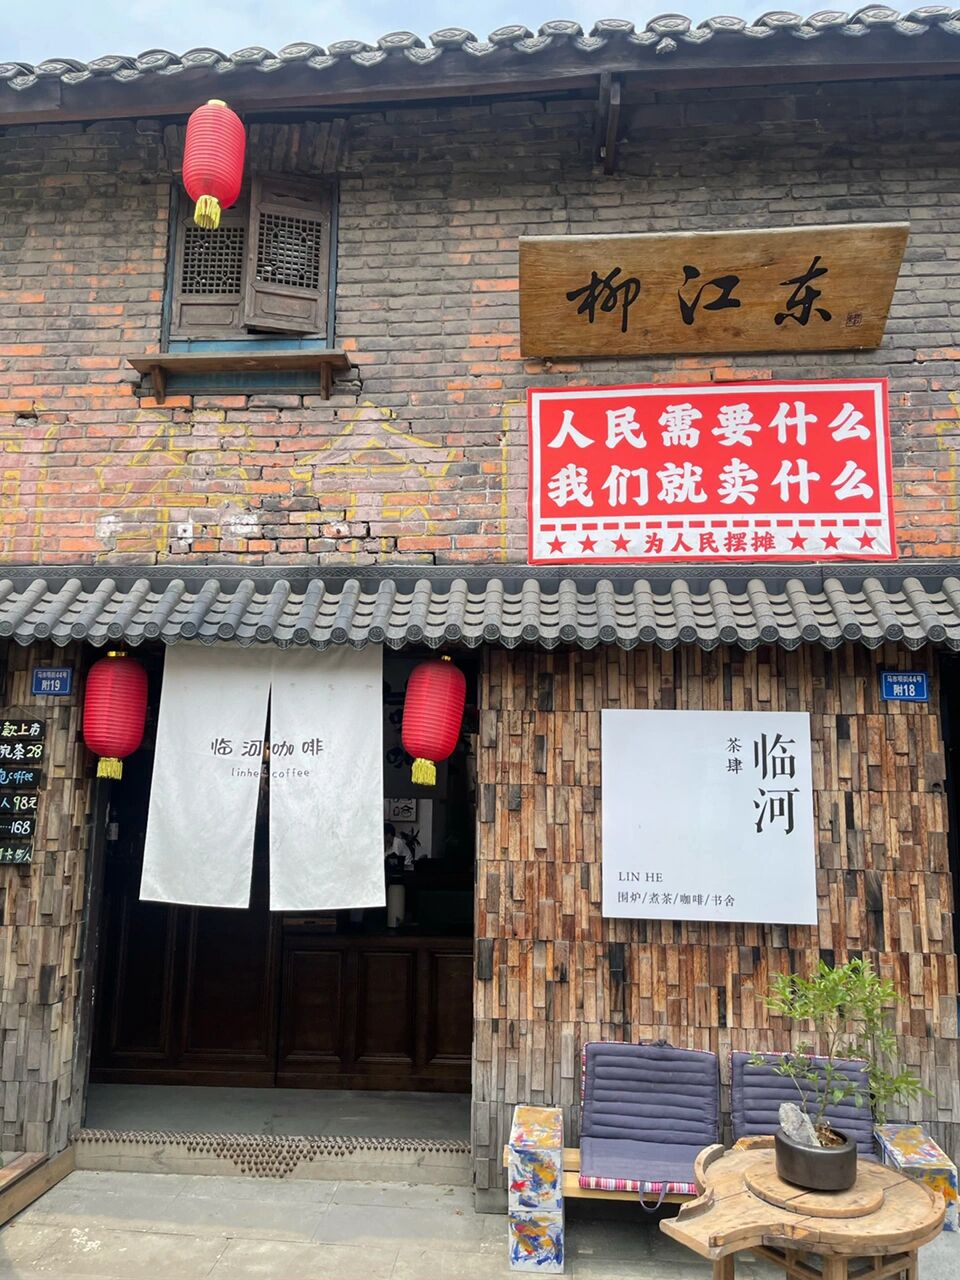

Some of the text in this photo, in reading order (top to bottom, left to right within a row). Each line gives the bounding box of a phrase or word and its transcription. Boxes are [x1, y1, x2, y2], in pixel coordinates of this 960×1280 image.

[566, 255, 834, 333] 柳江东
[546, 400, 872, 450] 人民需要什么
[546, 457, 874, 508] 我们就卖什么
[643, 531, 777, 554] 为人民摆摊
[41, 679, 60, 691] 附19
[893, 684, 916, 696] 附18
[0, 721, 41, 737] 款上市
[210, 737, 324, 757] 临河咖啡
[725, 737, 743, 774] 茶肆
[271, 768, 310, 778] coffee
[753, 733, 800, 835] 临河
[618, 871, 664, 883] LIN HE
[617, 891, 736, 907] 围炉/煮茶/咖啡/书舍
